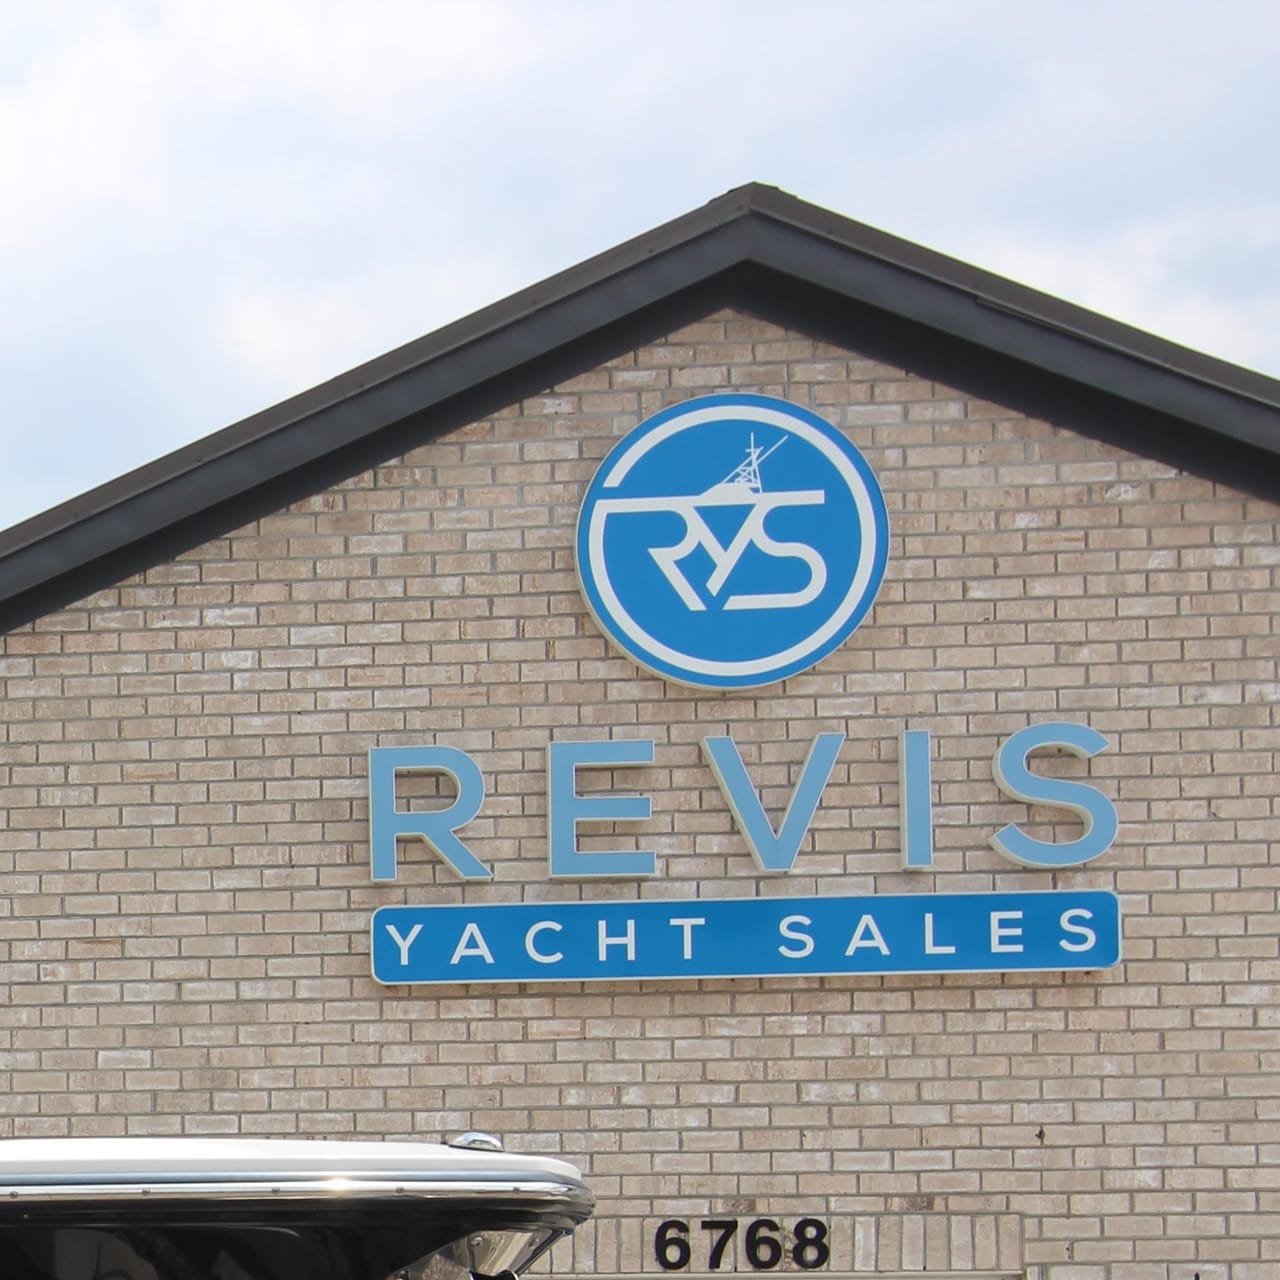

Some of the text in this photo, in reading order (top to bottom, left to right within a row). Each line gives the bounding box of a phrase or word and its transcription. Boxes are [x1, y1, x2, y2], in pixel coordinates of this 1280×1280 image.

[367, 722, 1120, 883] REVIS
[385, 908, 1098, 966] YACHT SALES
[654, 1218, 831, 1270] 6768
